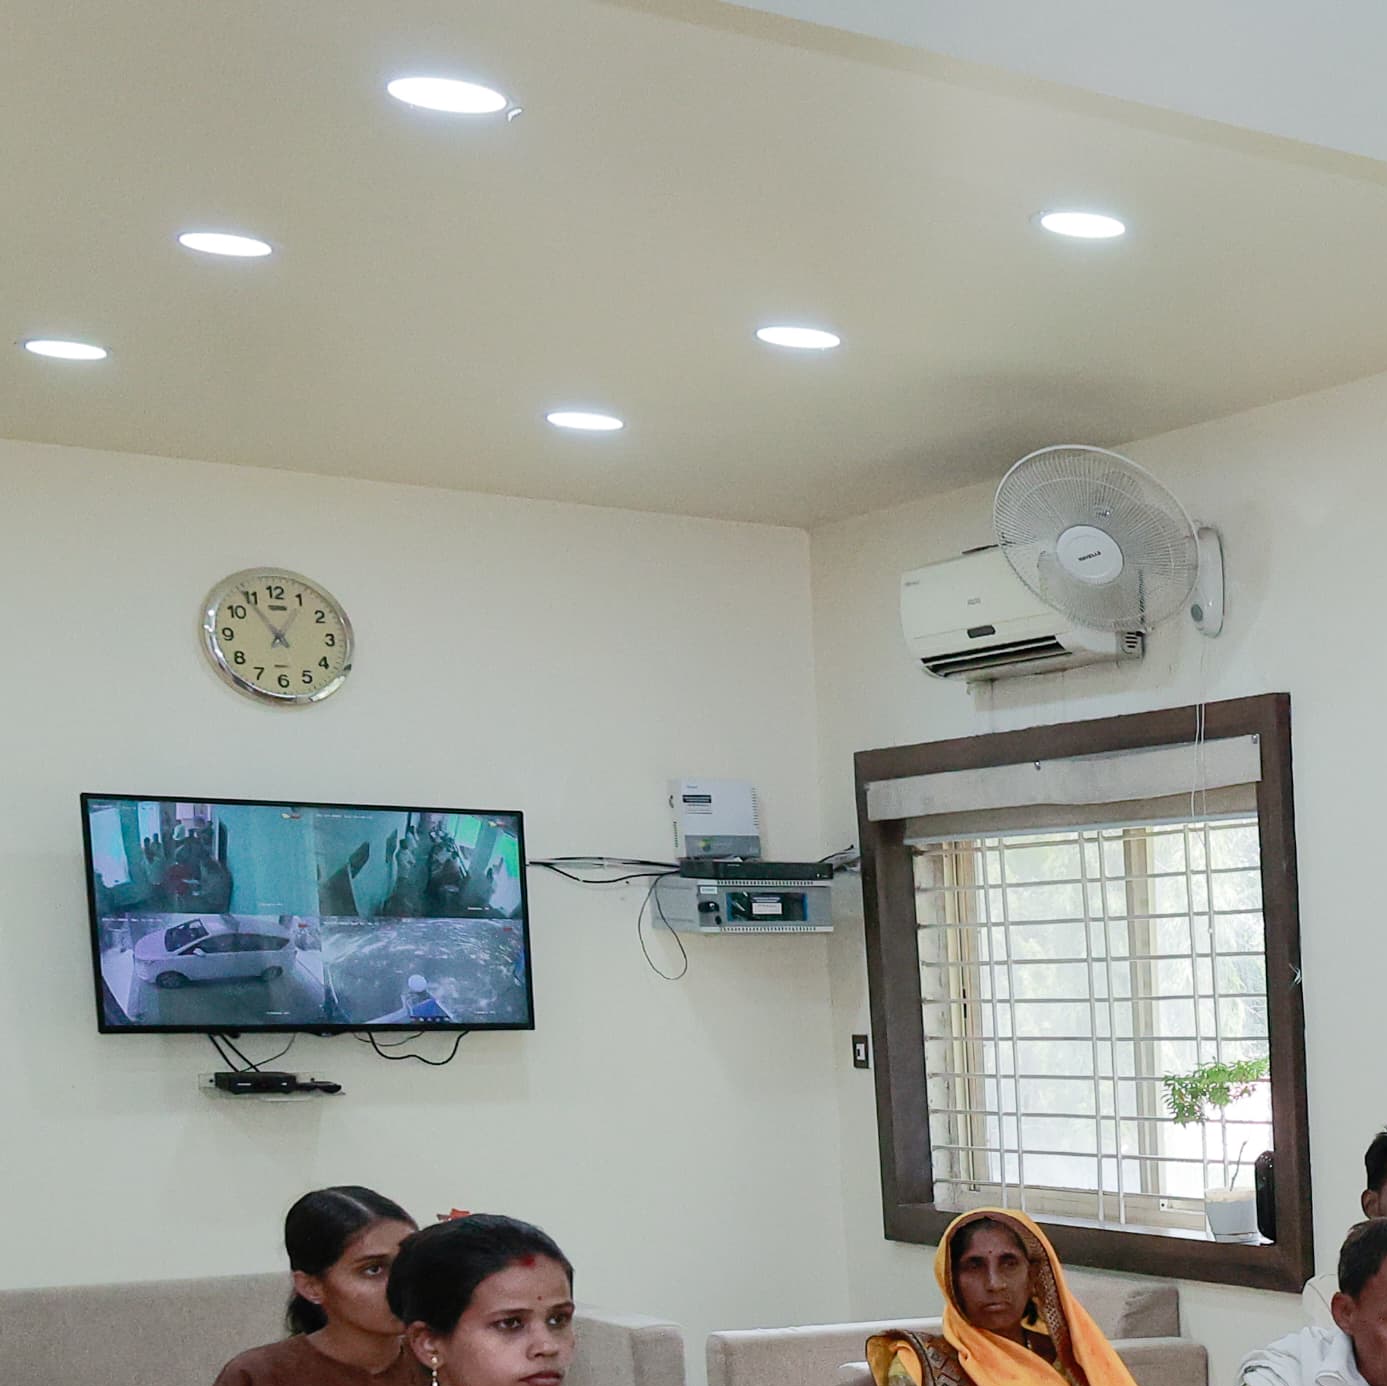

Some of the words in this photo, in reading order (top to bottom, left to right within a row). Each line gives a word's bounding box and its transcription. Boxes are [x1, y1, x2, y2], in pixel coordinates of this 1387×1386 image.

[245, 591, 258, 605] 11
[266, 585, 285, 600] 12
[296, 594, 303, 607] 1
[227, 605, 247, 620] 10
[314, 610, 326, 624] 2
[222, 627, 234, 641] 9
[324, 633, 335, 647] 3
[234, 650, 246, 665] 8
[318, 656, 330, 670] 4
[253, 666, 265, 681] 7
[301, 670, 313, 684] 5
[277, 674, 290, 689] 6
